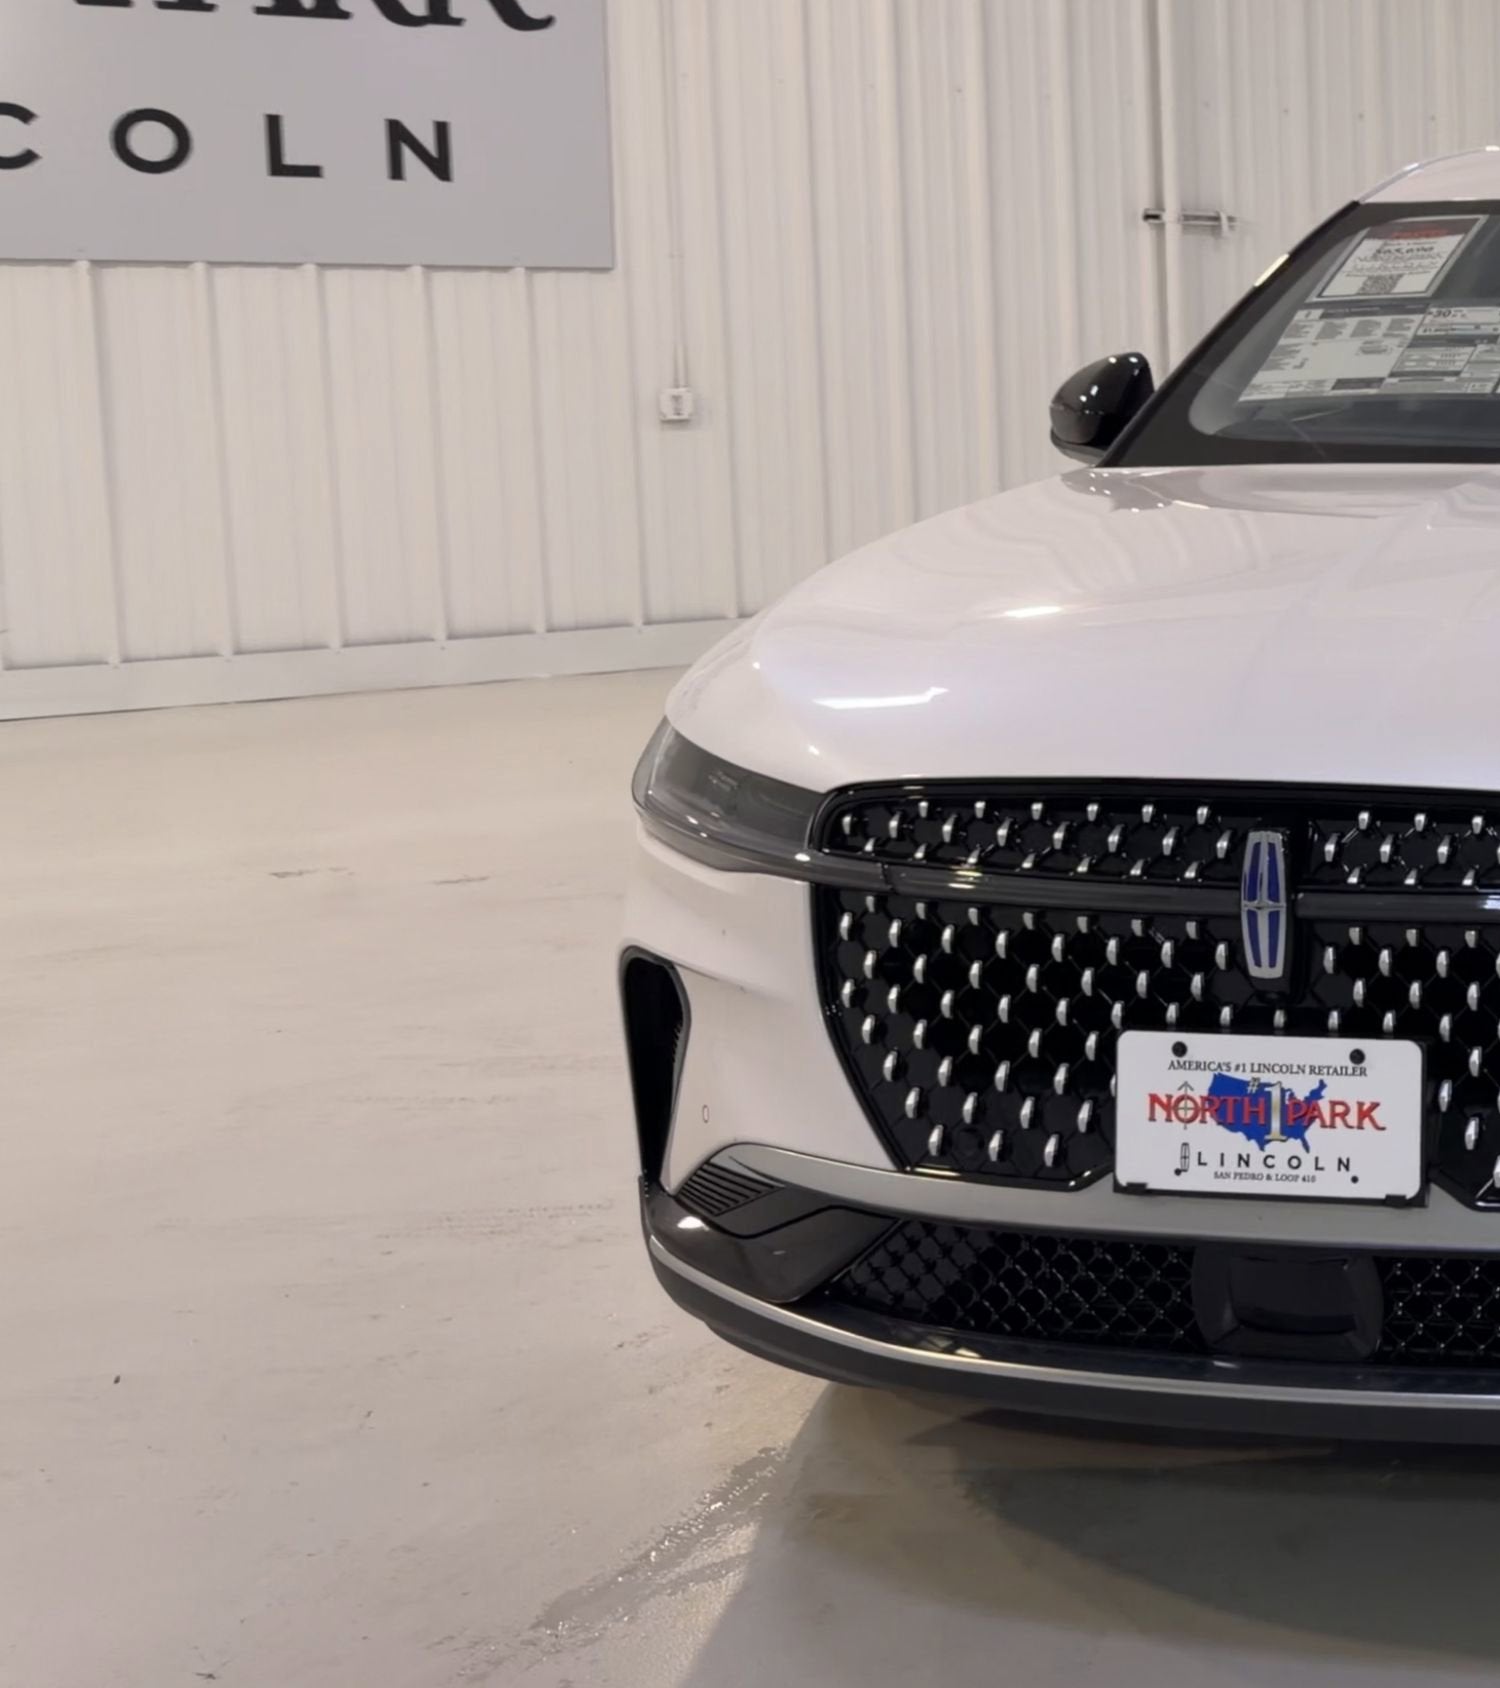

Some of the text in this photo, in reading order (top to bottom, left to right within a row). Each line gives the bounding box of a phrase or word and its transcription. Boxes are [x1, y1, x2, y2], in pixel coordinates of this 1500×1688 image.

[1168, 1060, 1368, 1077] AMERICA'S #1 LINCOLN RETAILER
[1148, 1093, 1387, 1131] NORTH PARK
[1197, 1151, 1351, 1173] LINCOLN
[1214, 1171, 1231, 1180] SAN
[1233, 1172, 1264, 1181] PEDRO
[1266, 1173, 1273, 1181] &
[1275, 1174, 1300, 1182] LOOP
